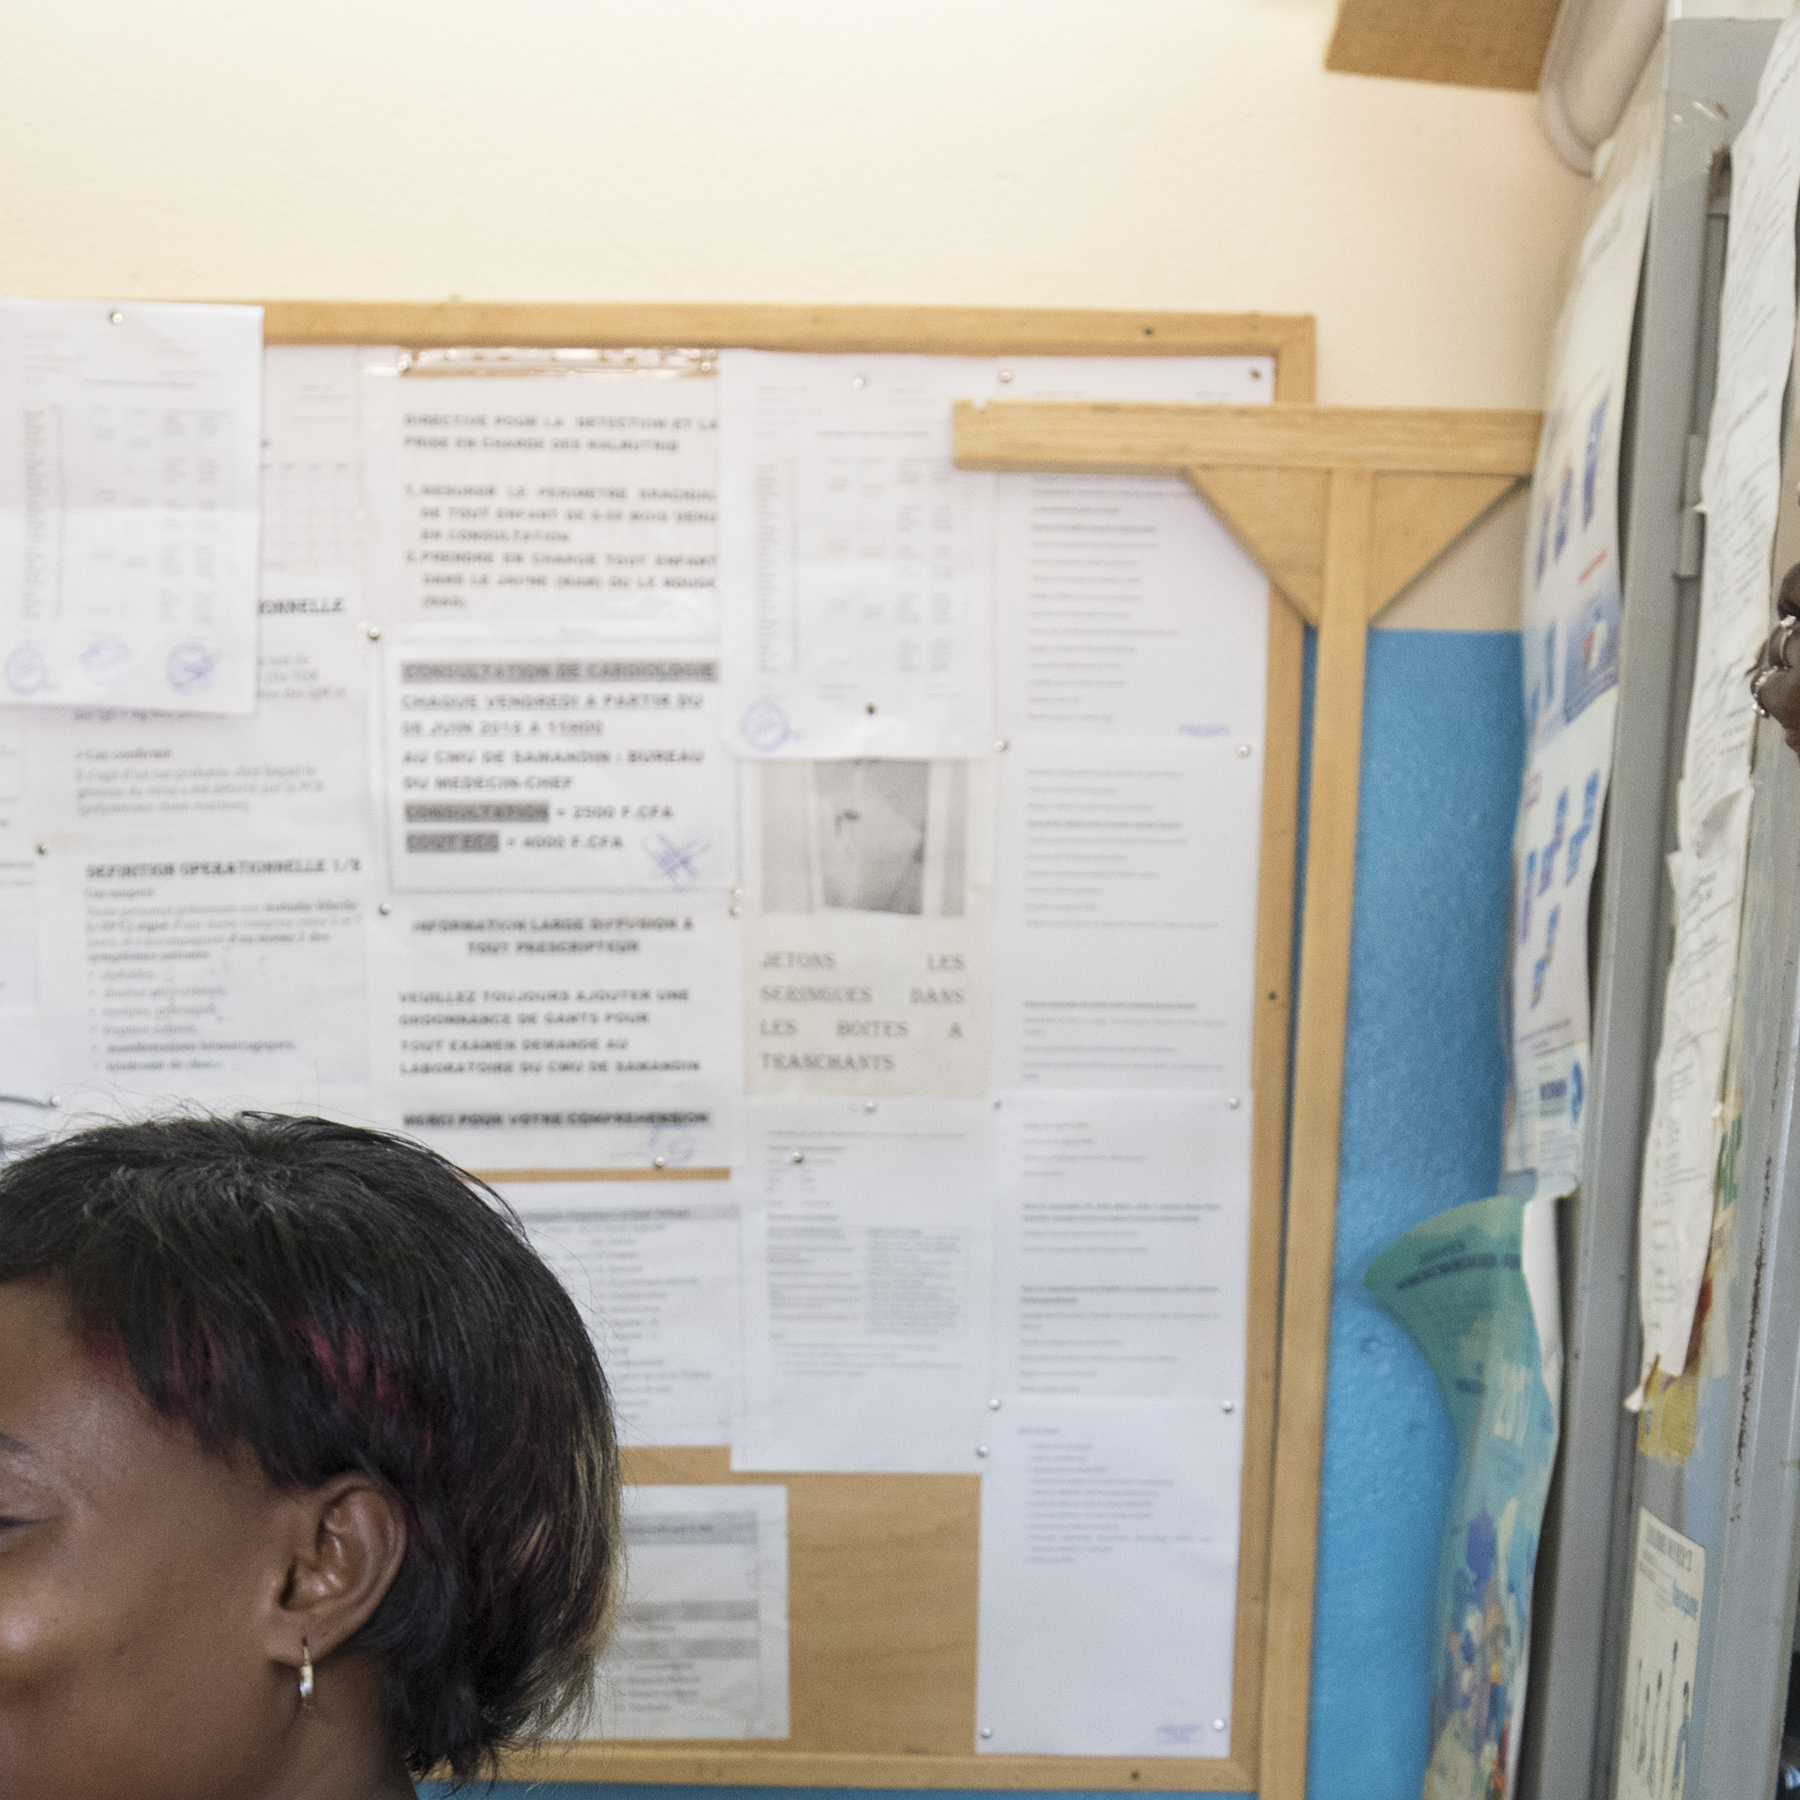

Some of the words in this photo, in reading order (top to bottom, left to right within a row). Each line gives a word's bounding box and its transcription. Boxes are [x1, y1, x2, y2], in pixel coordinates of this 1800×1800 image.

[403, 414, 486, 427] DIRECTIVE
[493, 414, 537, 427] POUR
[543, 415, 564, 427] LA
[576, 415, 667, 429] DETECTION
[697, 417, 719, 430] LA
[403, 435, 449, 448] PRISE
[455, 437, 476, 449] EN
[480, 437, 545, 449] CHARGE
[550, 438, 581, 450] DES
[420, 484, 497, 497] MESURER
[507, 485, 526, 497] LE
[420, 507, 440, 519] DE
[447, 507, 490, 520] TOUT
[495, 508, 559, 521] ENFANT
[564, 509, 584, 521] DE
[420, 529, 442, 541] EN
[448, 530, 571, 543] CONSULTATION
[420, 551, 495, 563] PRENDRE
[503, 552, 524, 564] EN
[531, 553, 596, 565] CHARGE
[606, 554, 647, 566] TOUT
[655, 554, 718, 567] ENFANT
[423, 573, 464, 585] DANS
[470, 573, 489, 586] LE
[637, 577, 655, 588] LE
[404, 661, 551, 680] CONSULTATION
[400, 693, 479, 708] CHAQUE
[485, 693, 580, 708] VENDREDI
[602, 694, 672, 708] PARTIR
[676, 694, 705, 707] DU
[428, 720, 474, 734] JUIN
[401, 749, 429, 764] AU
[481, 749, 506, 764] DE
[626, 749, 706, 764] BUREAU
[402, 776, 429, 790] DU
[86, 861, 176, 878] DEFINITION
[411, 918, 527, 932] INFORMATION
[529, 917, 584, 930] LARGE
[589, 917, 678, 930] DIFFUSION
[466, 940, 509, 954] TOUT
[514, 940, 641, 954] PRESCRIPTEUR
[759, 951, 837, 970] JETONS
[926, 952, 965, 971] LES
[398, 989, 477, 1003] VEUILLEZ
[481, 989, 570, 1003] TOUJOURS
[574, 989, 651, 1002] AJOUTER
[656, 989, 690, 1002] UNE
[759, 985, 873, 1004] SERINGUES
[909, 986, 965, 1005] DANS
[398, 1013, 512, 1026] ORDONNANCE
[516, 1013, 537, 1026] DE
[543, 1013, 599, 1026] GANTS
[604, 1013, 650, 1026] POUR
[759, 1018, 797, 1036] LES
[835, 1019, 909, 1038] BOITES
[948, 1020, 965, 1038] A
[401, 1038, 444, 1051] TOUT
[448, 1038, 516, 1051] EXAMEN
[605, 1038, 630, 1050] AU
[399, 1061, 515, 1075] LABORATOIRE
[519, 1061, 542, 1074] DU
[588, 1061, 609, 1074] DE
[759, 1052, 896, 1071] TRANCHANTS
[402, 1112, 455, 1127] MERCI
[458, 1112, 503, 1127] POUR
[508, 1112, 562, 1127] VOTRE
[566, 1112, 710, 1126] COMPREHENSION
